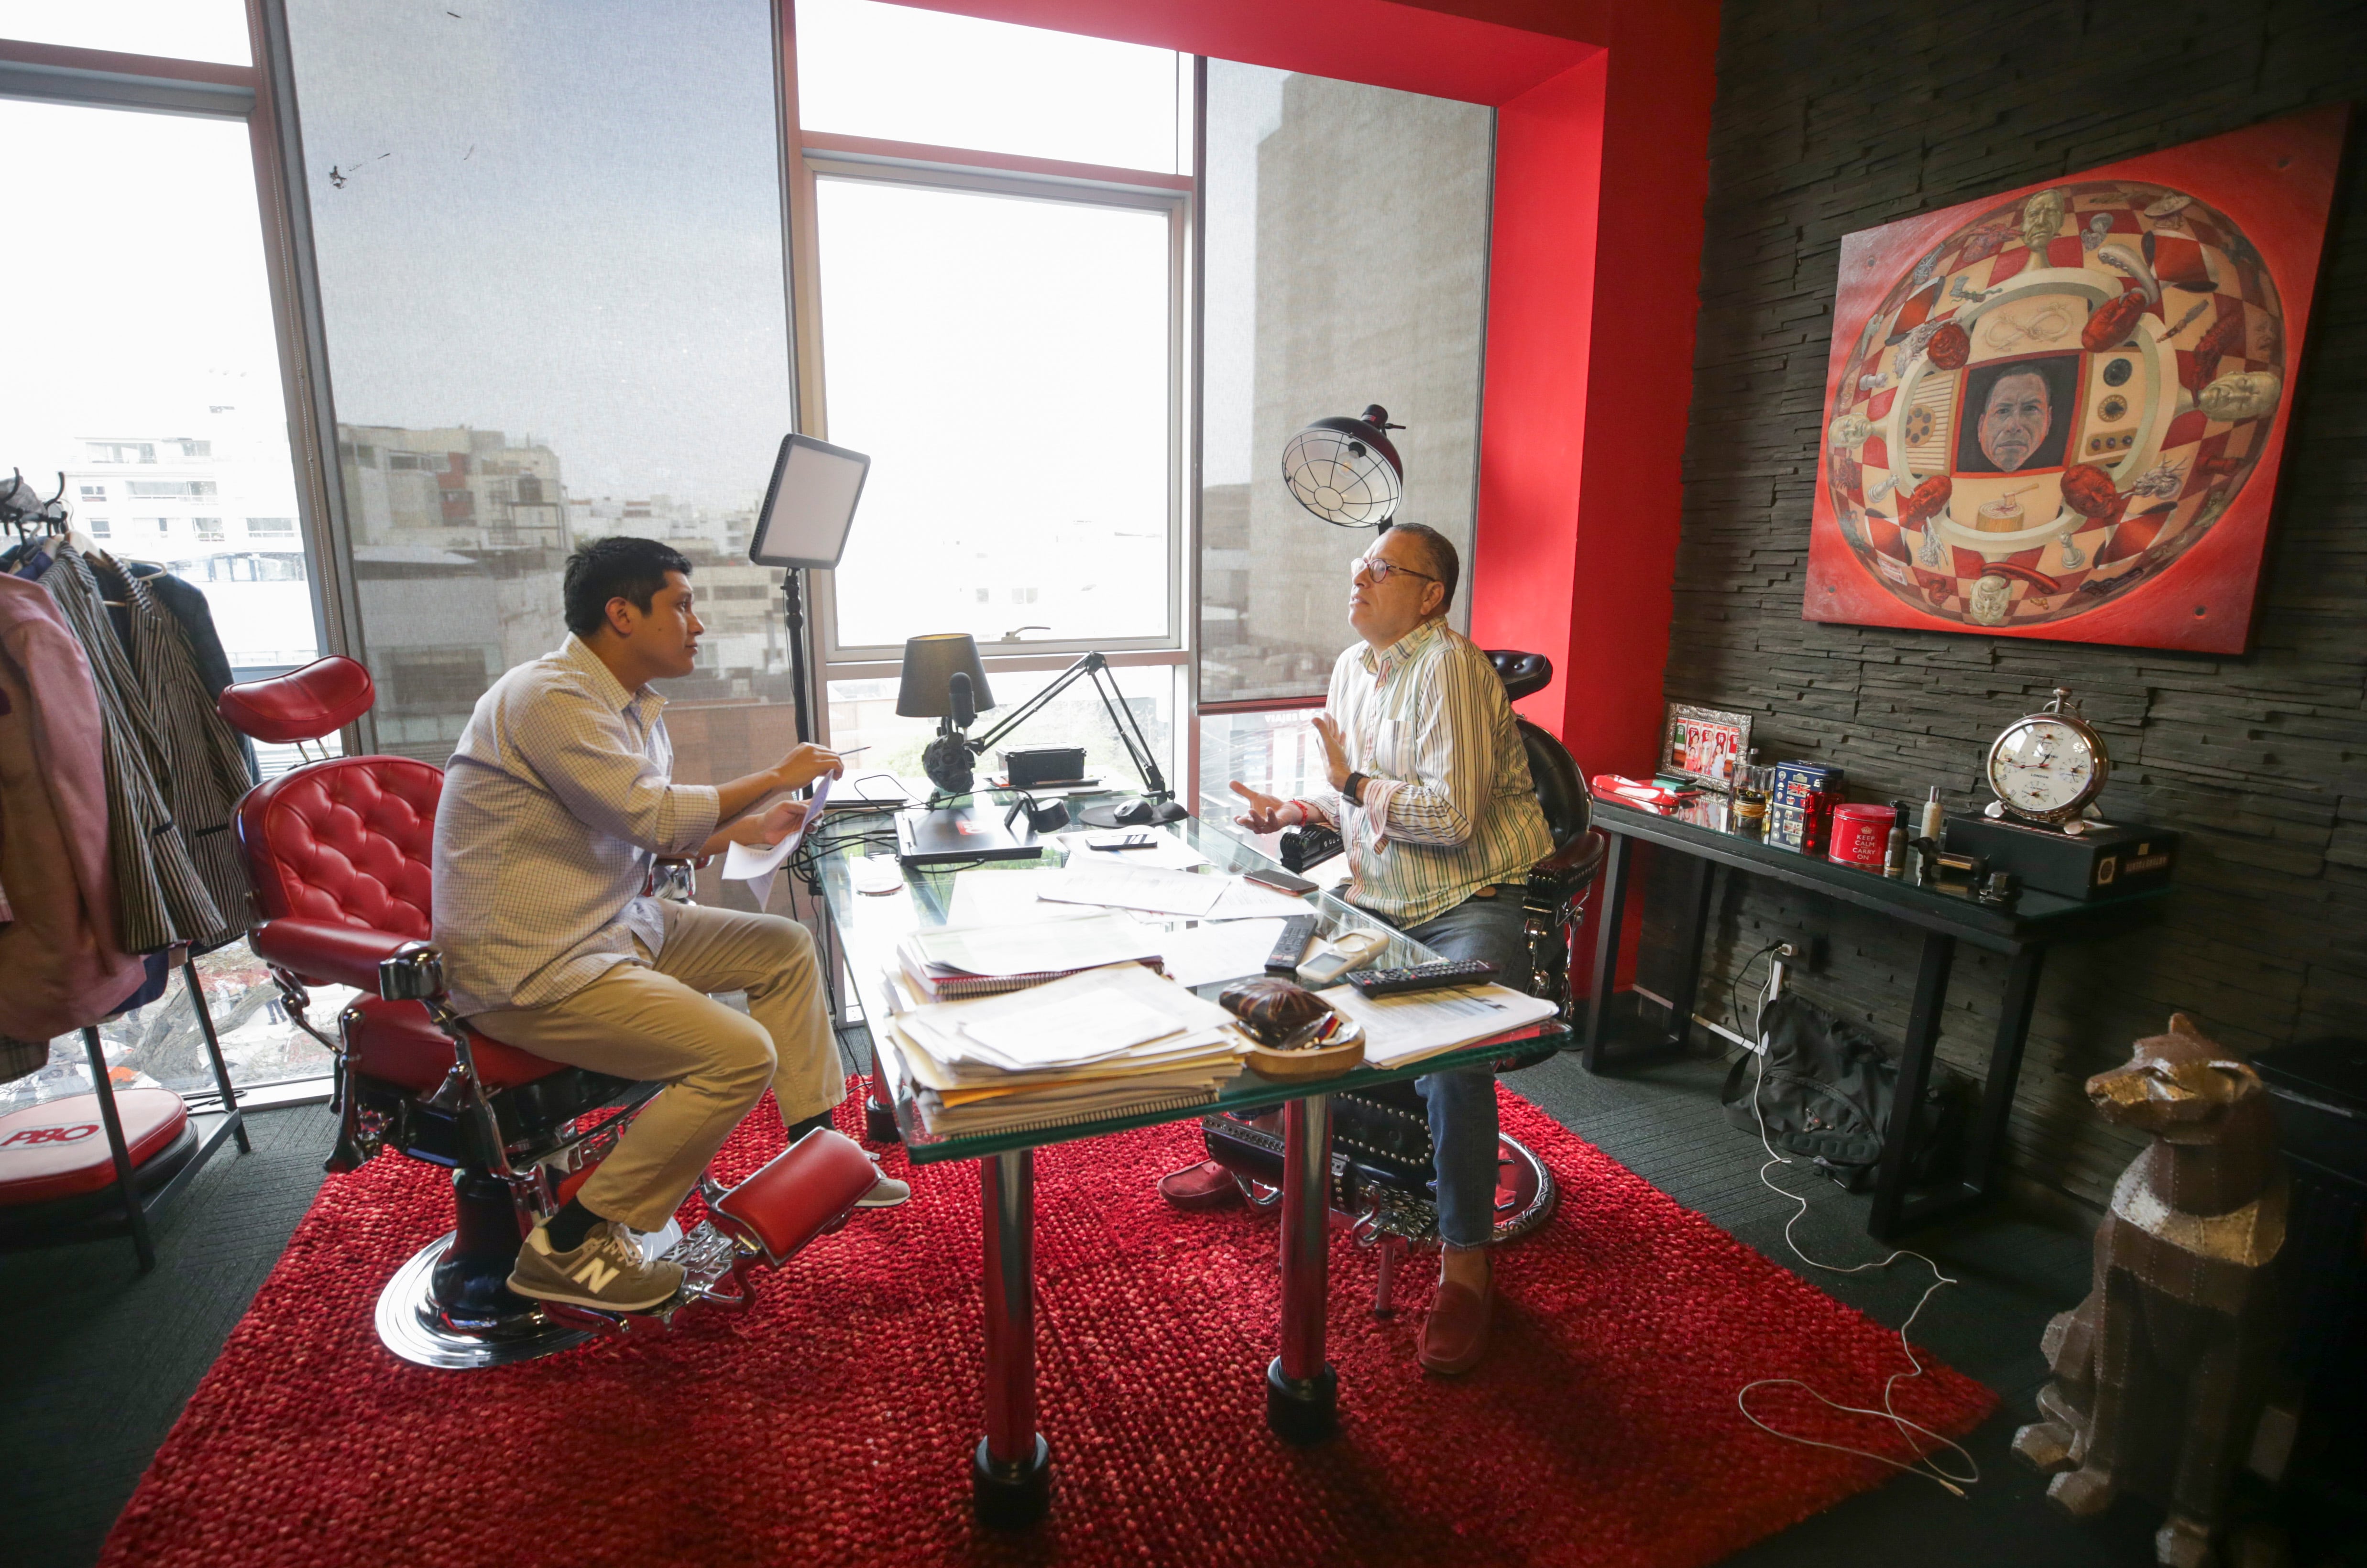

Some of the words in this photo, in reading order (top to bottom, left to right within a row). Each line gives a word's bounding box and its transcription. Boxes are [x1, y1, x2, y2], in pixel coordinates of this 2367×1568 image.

[1265, 713, 1298, 723] VIAJES
[0, 1124, 99, 1146] PBO
[571, 1257, 620, 1294] N
